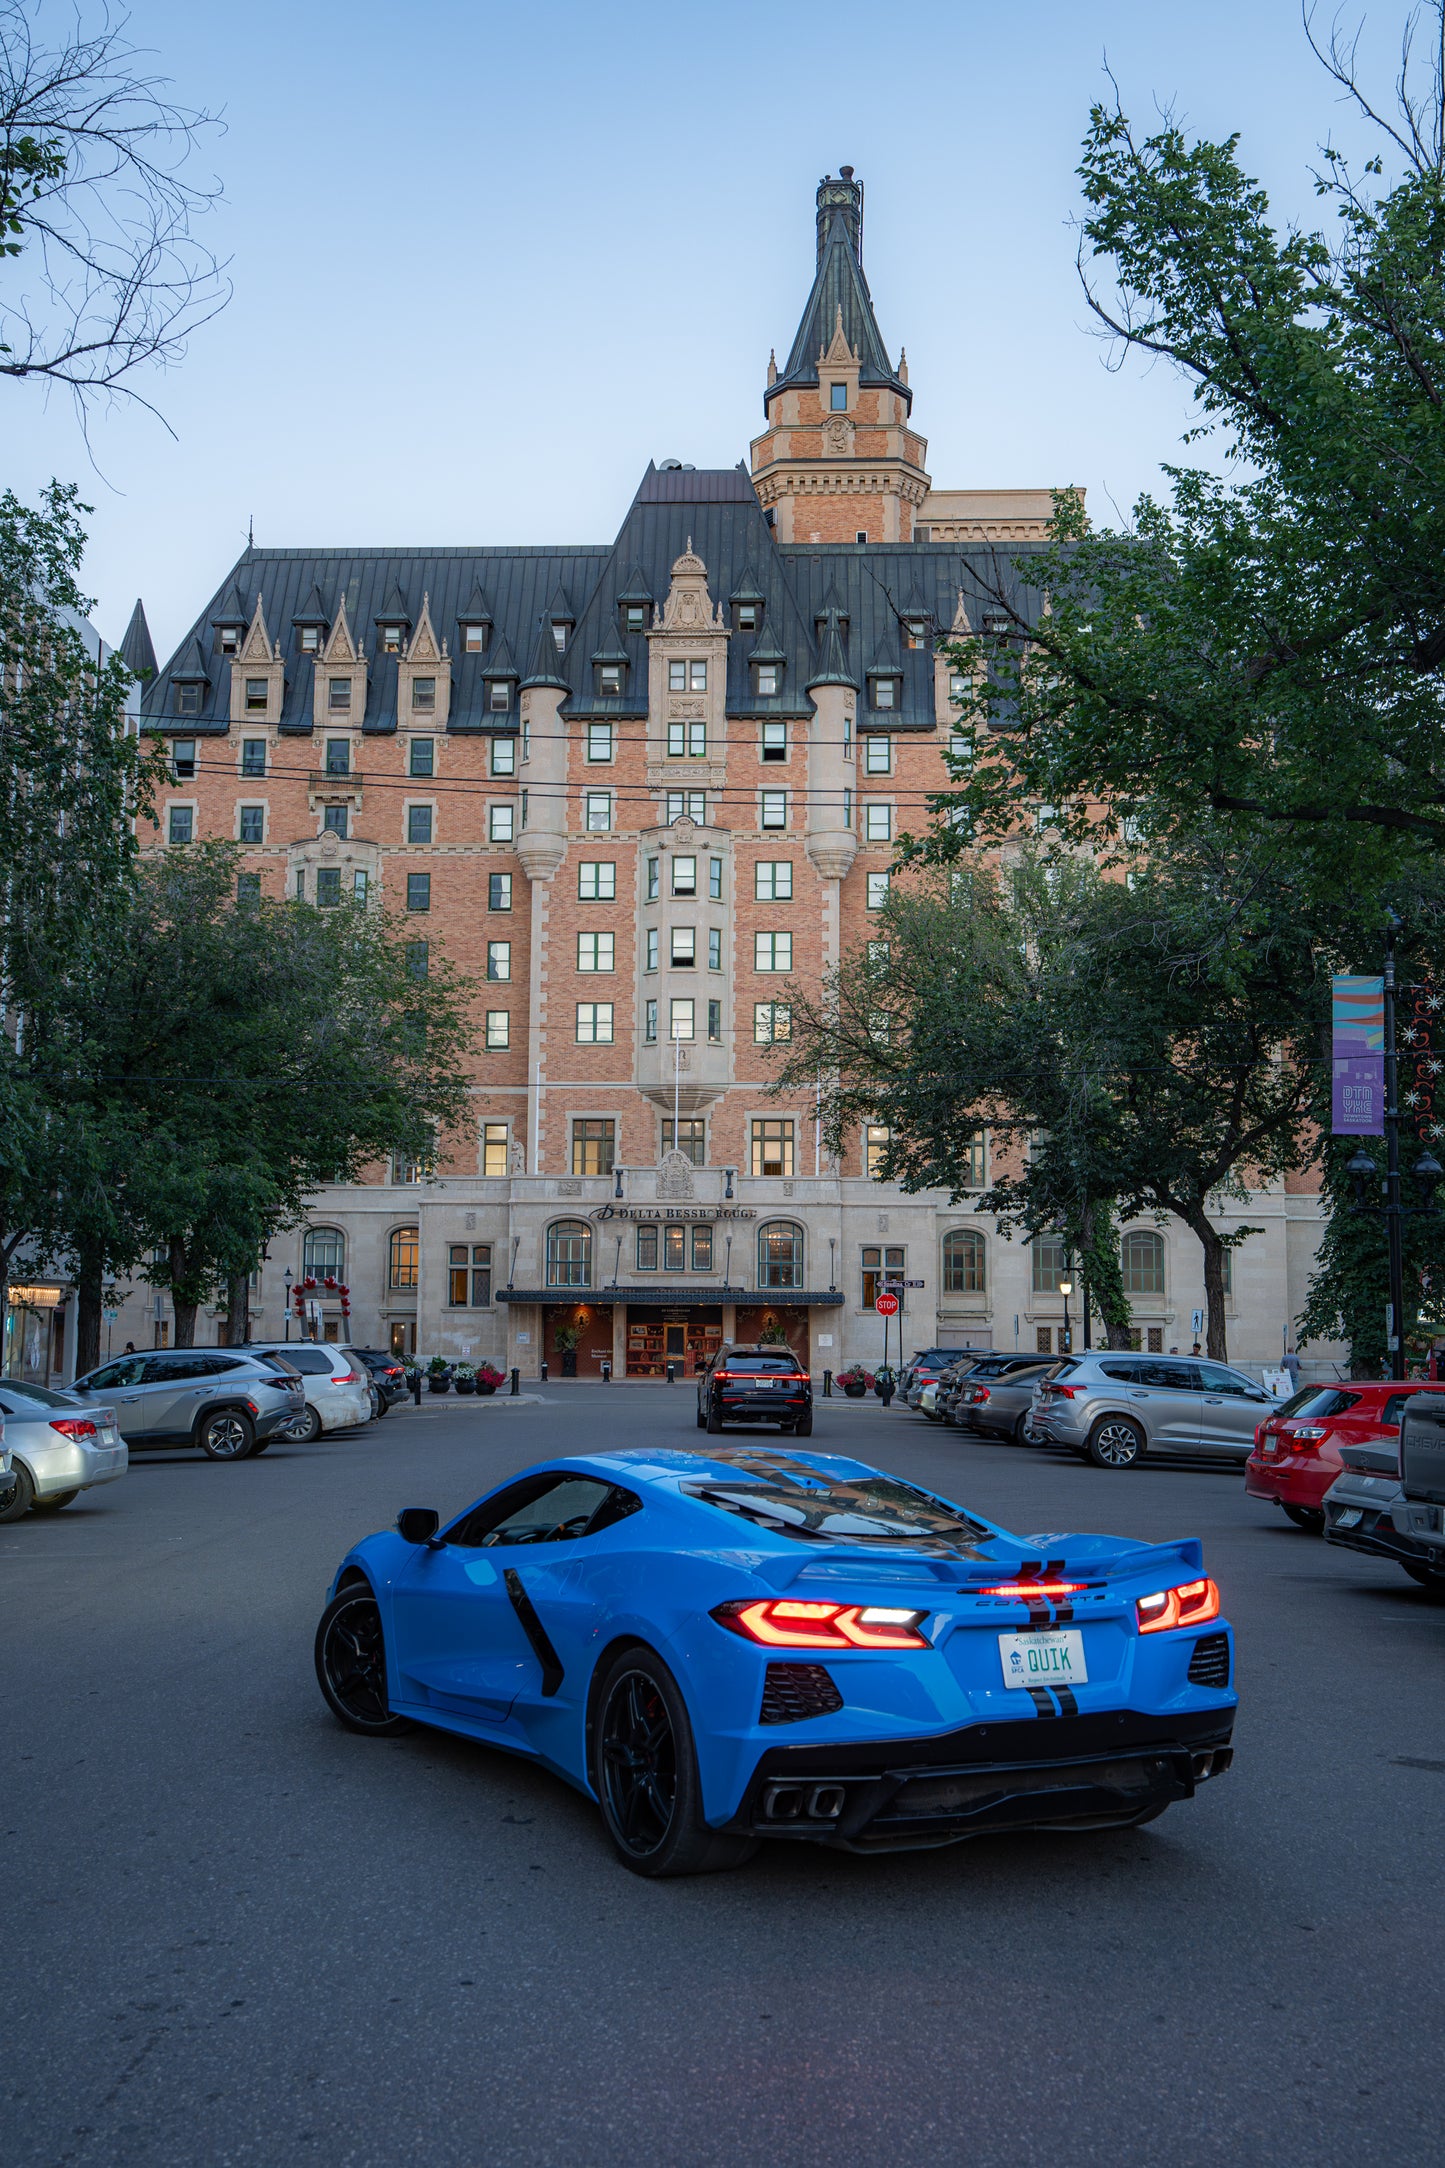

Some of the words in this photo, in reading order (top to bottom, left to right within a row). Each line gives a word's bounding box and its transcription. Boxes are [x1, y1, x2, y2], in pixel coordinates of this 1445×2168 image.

[1343, 1086, 1373, 1100] DTN
[1343, 1100, 1373, 1114] YXE
[619, 1207, 661, 1219] DELTA
[878, 1300, 897, 1310] STOP
[975, 1594, 1106, 1607] CORVETTE
[1018, 1635, 1065, 1646] Saskatchewan
[1028, 1647, 1072, 1672] QUIK
